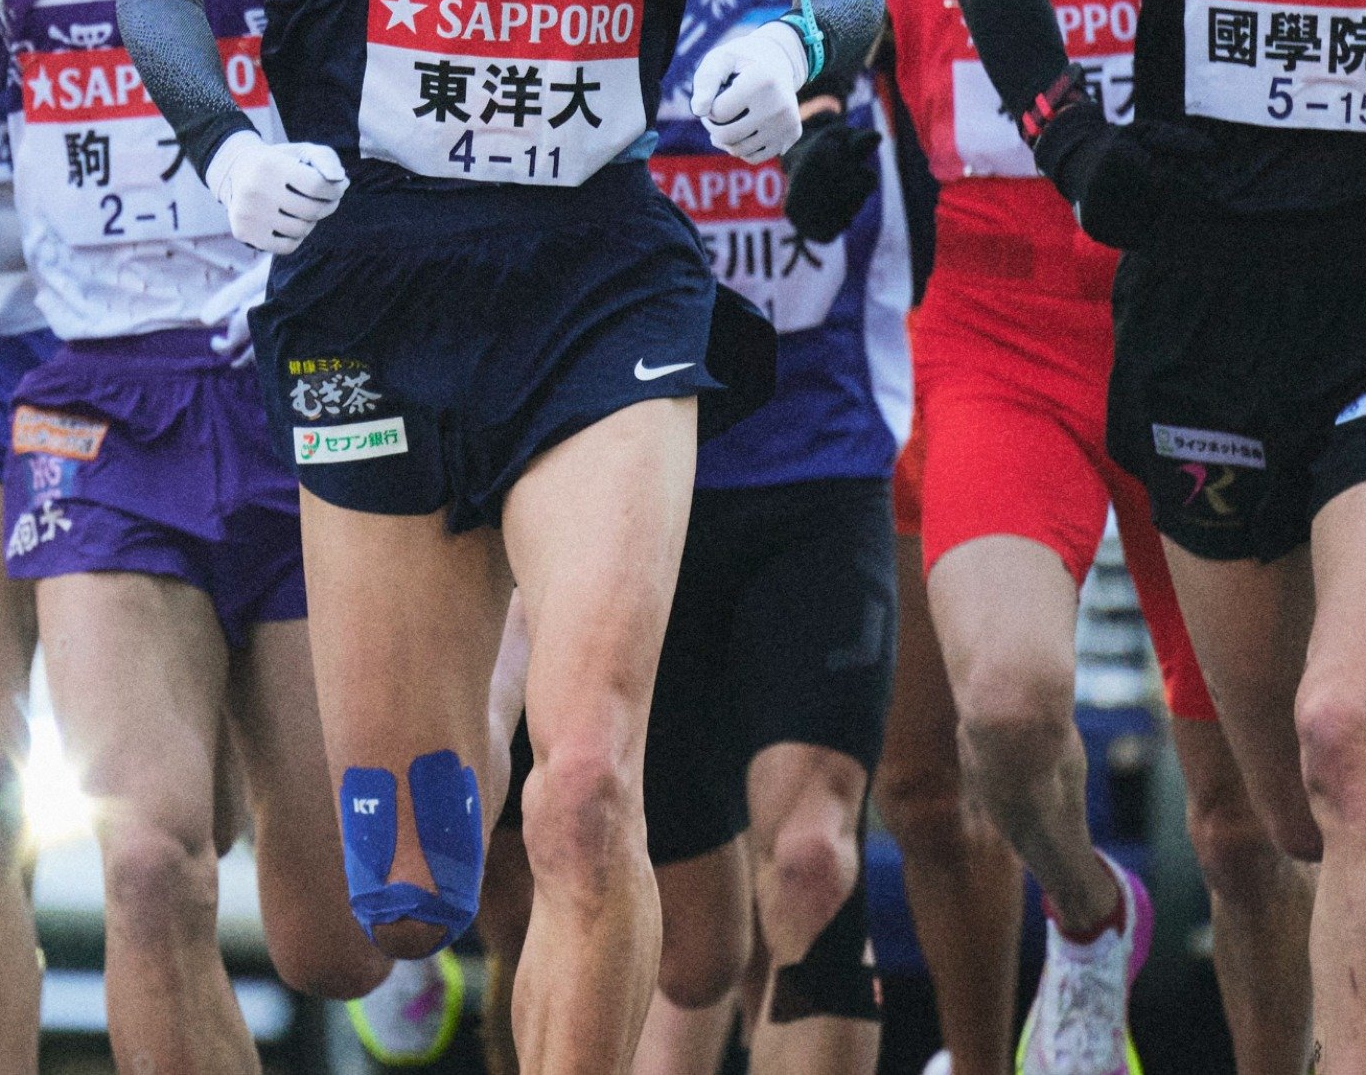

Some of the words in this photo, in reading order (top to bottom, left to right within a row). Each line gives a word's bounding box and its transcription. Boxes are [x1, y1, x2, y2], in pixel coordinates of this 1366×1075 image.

[413, 60, 602, 130] 東洋大
[448, 129, 561, 179] 4-11
[100, 194, 180, 237] 2-1
[290, 371, 383, 420] むぎ茶
[326, 428, 398, 453] セブン銀行
[353, 797, 380, 816] KT
